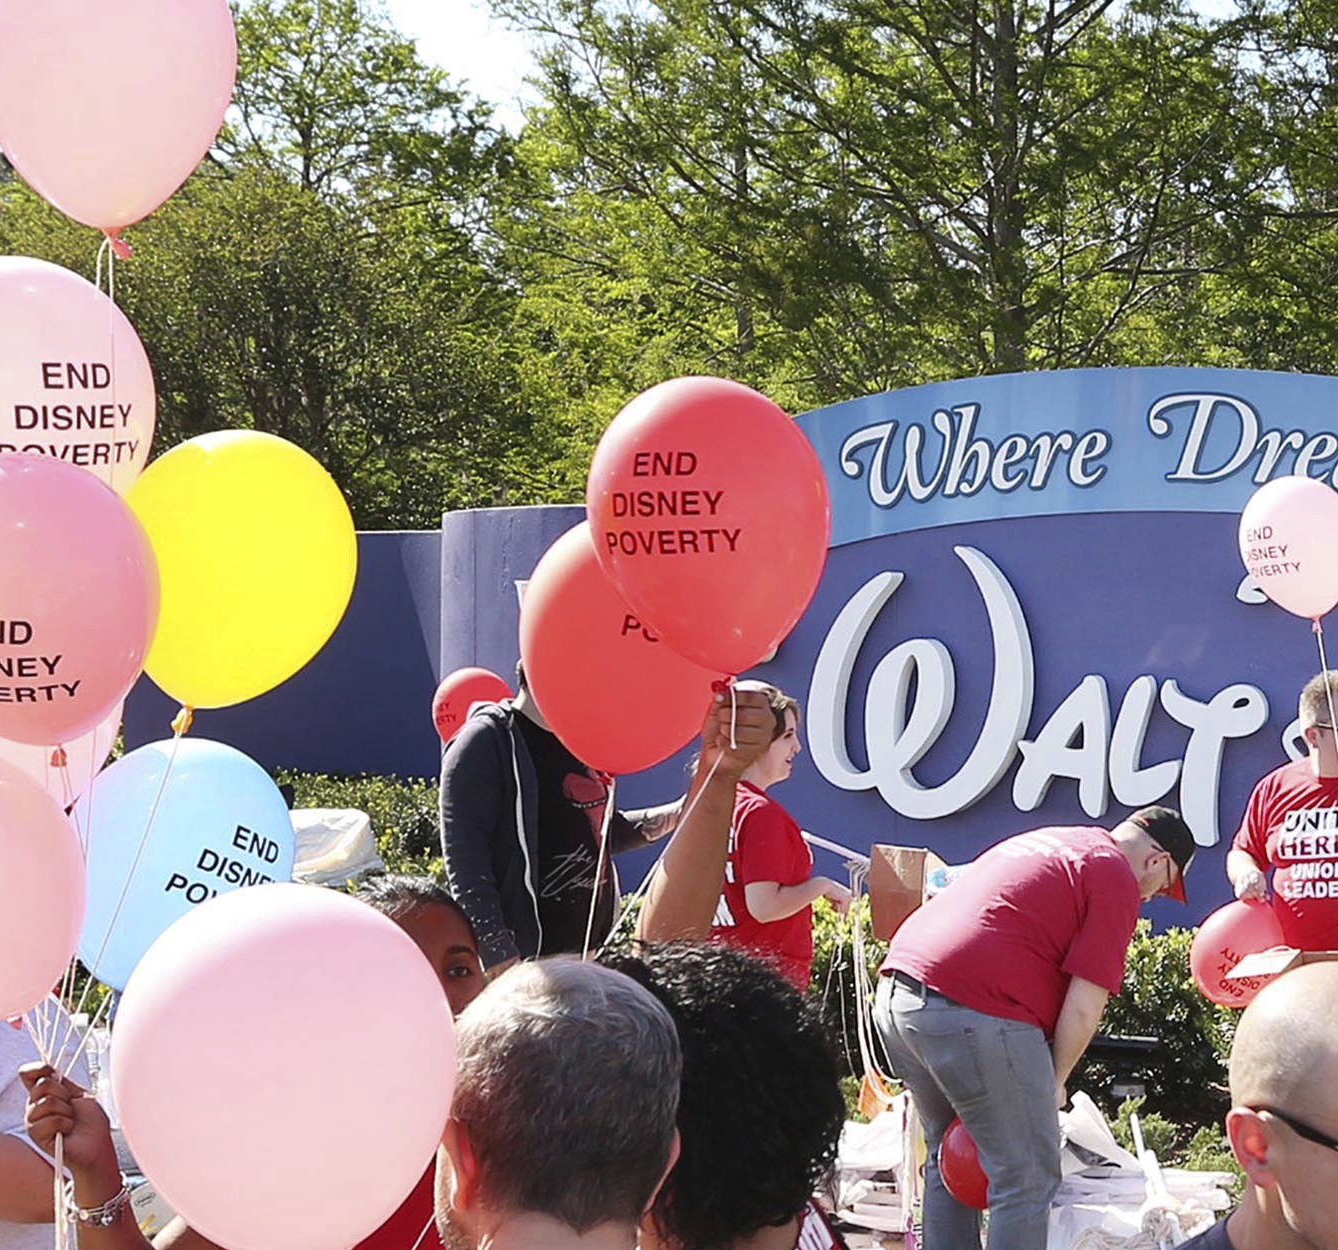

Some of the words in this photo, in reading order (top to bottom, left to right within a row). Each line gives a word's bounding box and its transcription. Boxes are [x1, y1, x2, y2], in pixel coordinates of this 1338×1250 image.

[41, 362, 111, 389] END
[14, 403, 132, 430] DISNEY
[632, 451, 698, 477] END
[841, 404, 1113, 508] Where
[611, 490, 725, 518] DISNEY
[605, 528, 743, 556] POVERTY
[232, 824, 280, 864] END
[196, 848, 276, 888] DISN
